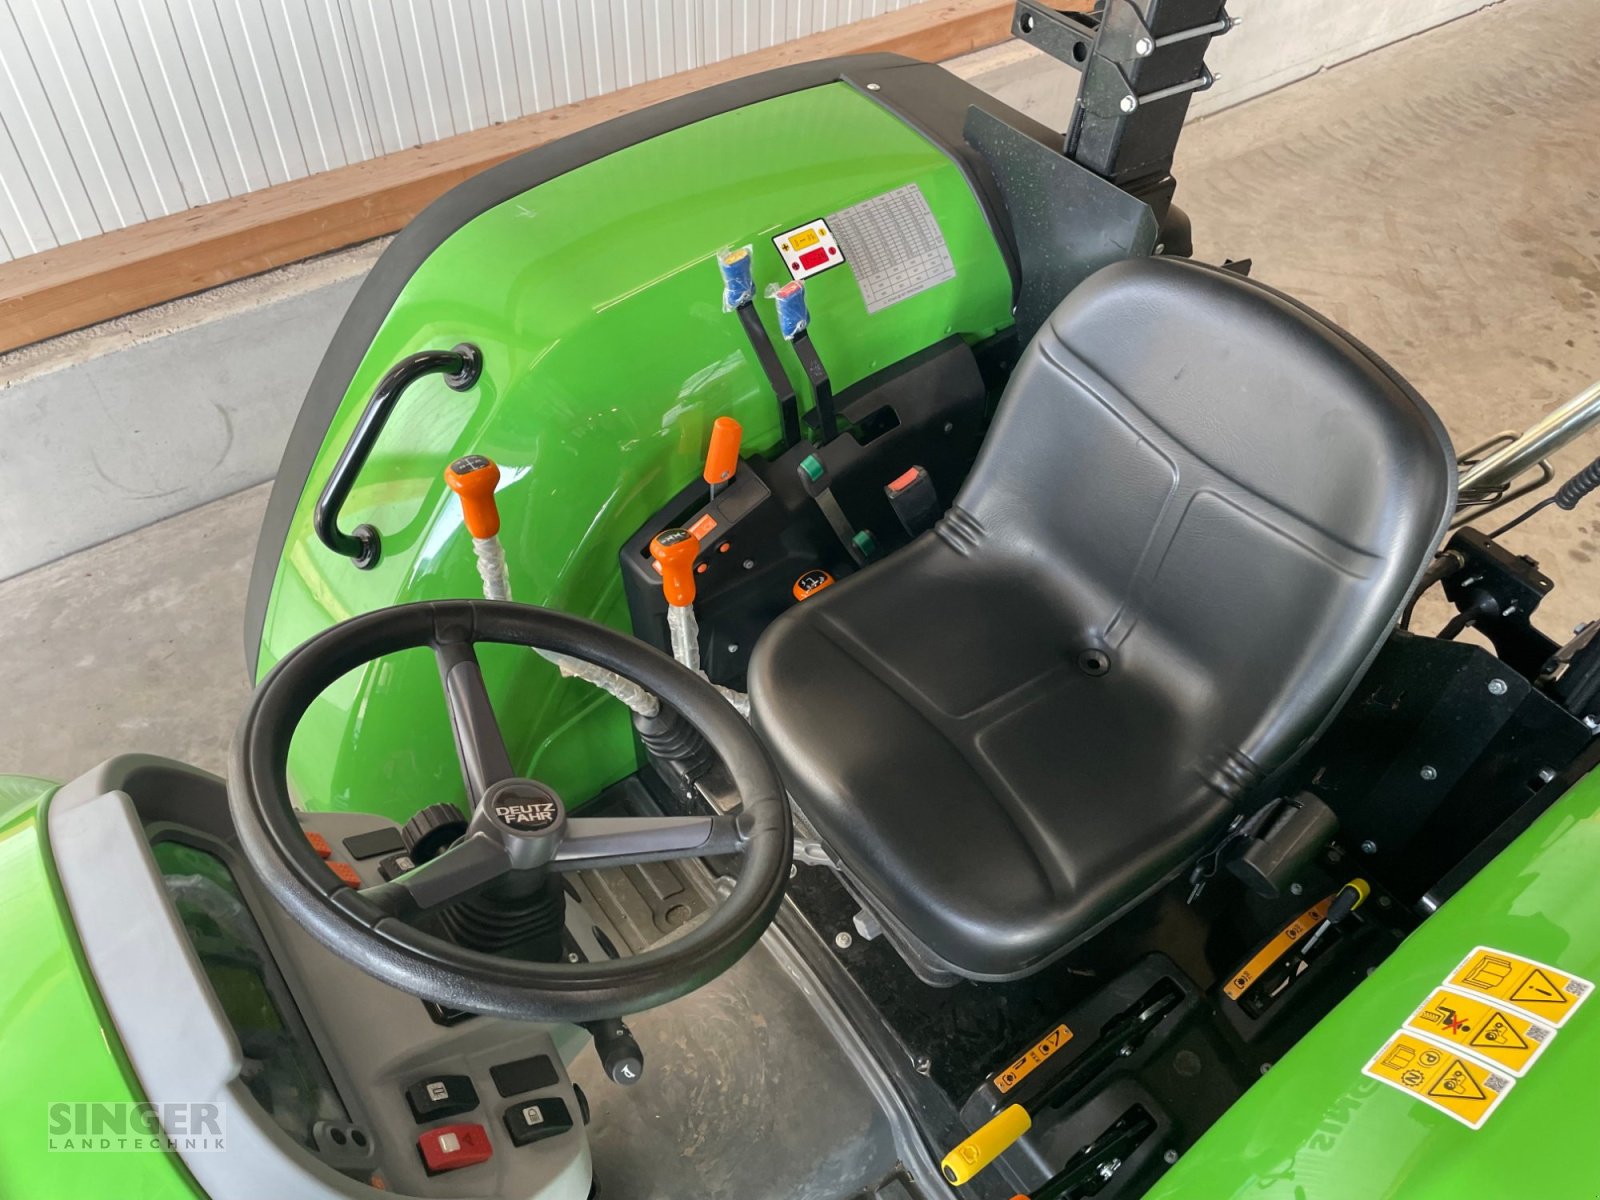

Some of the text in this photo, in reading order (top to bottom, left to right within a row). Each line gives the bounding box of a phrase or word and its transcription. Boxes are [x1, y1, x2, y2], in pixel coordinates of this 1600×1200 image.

[495, 803, 556, 816] DEUTZ
[504, 812, 553, 824] FAHR
[1405, 1072, 1420, 1084] N
